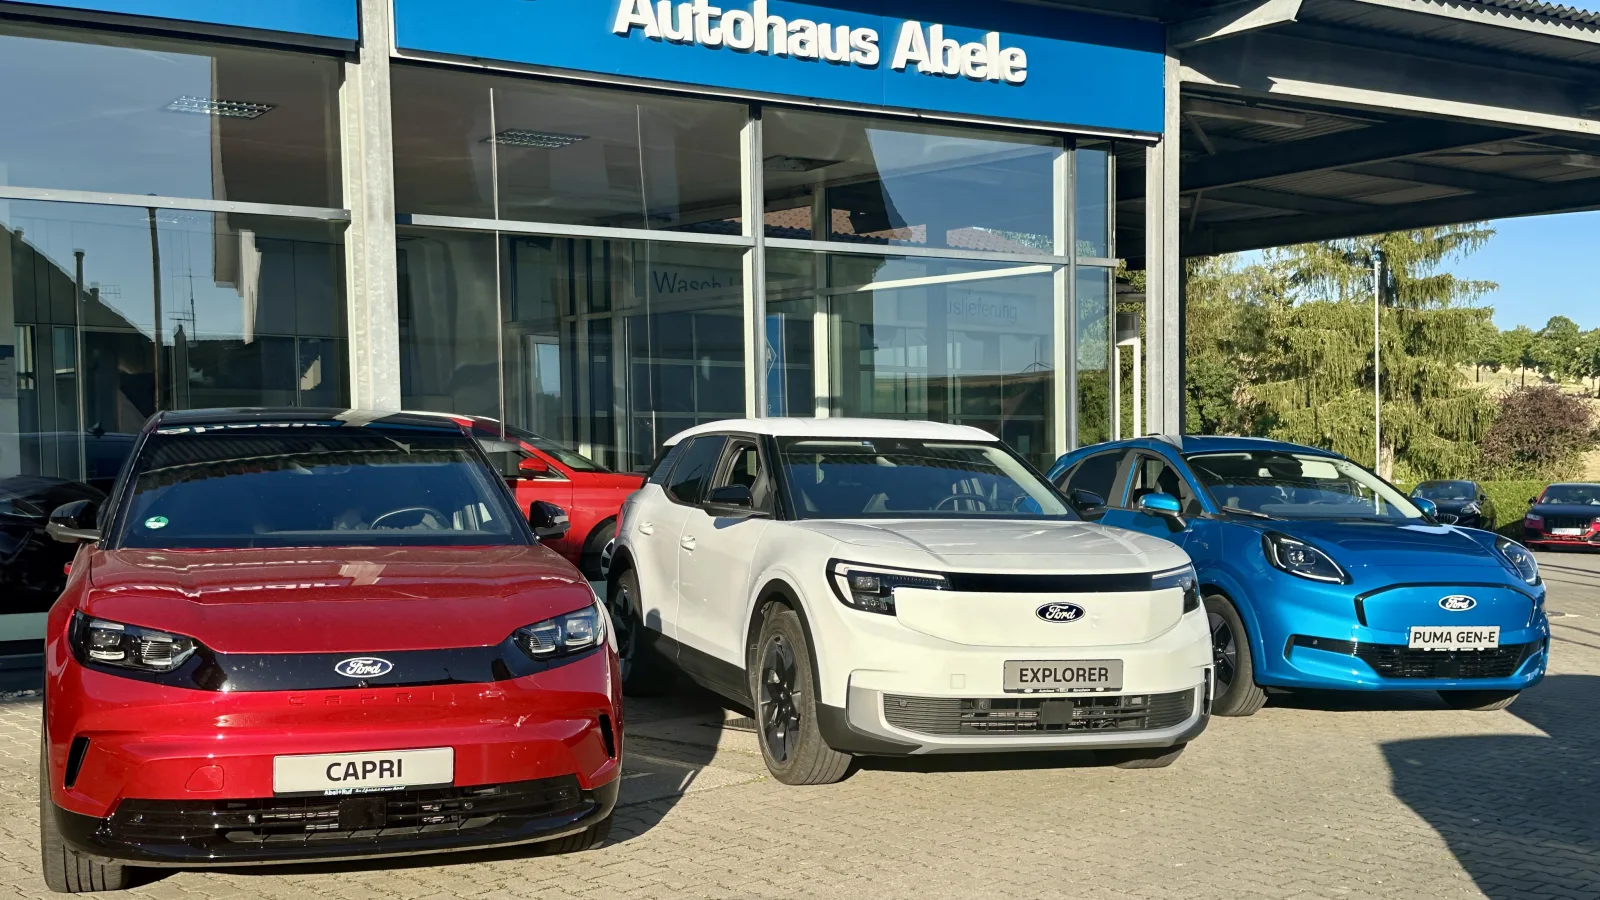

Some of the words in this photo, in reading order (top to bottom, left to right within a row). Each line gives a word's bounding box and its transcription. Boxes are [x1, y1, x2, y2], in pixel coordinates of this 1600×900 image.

[612, 0, 880, 67] Autohaus
[891, 20, 1028, 84] Abele
[946, 296, 1018, 324] uslieferung
[1413, 631, 1452, 643] PUMA
[1456, 631, 1496, 643] GEN-E
[1019, 667, 1109, 683] EXPLORER
[289, 691, 436, 707] CAPRI
[326, 758, 403, 782] CAPRI
